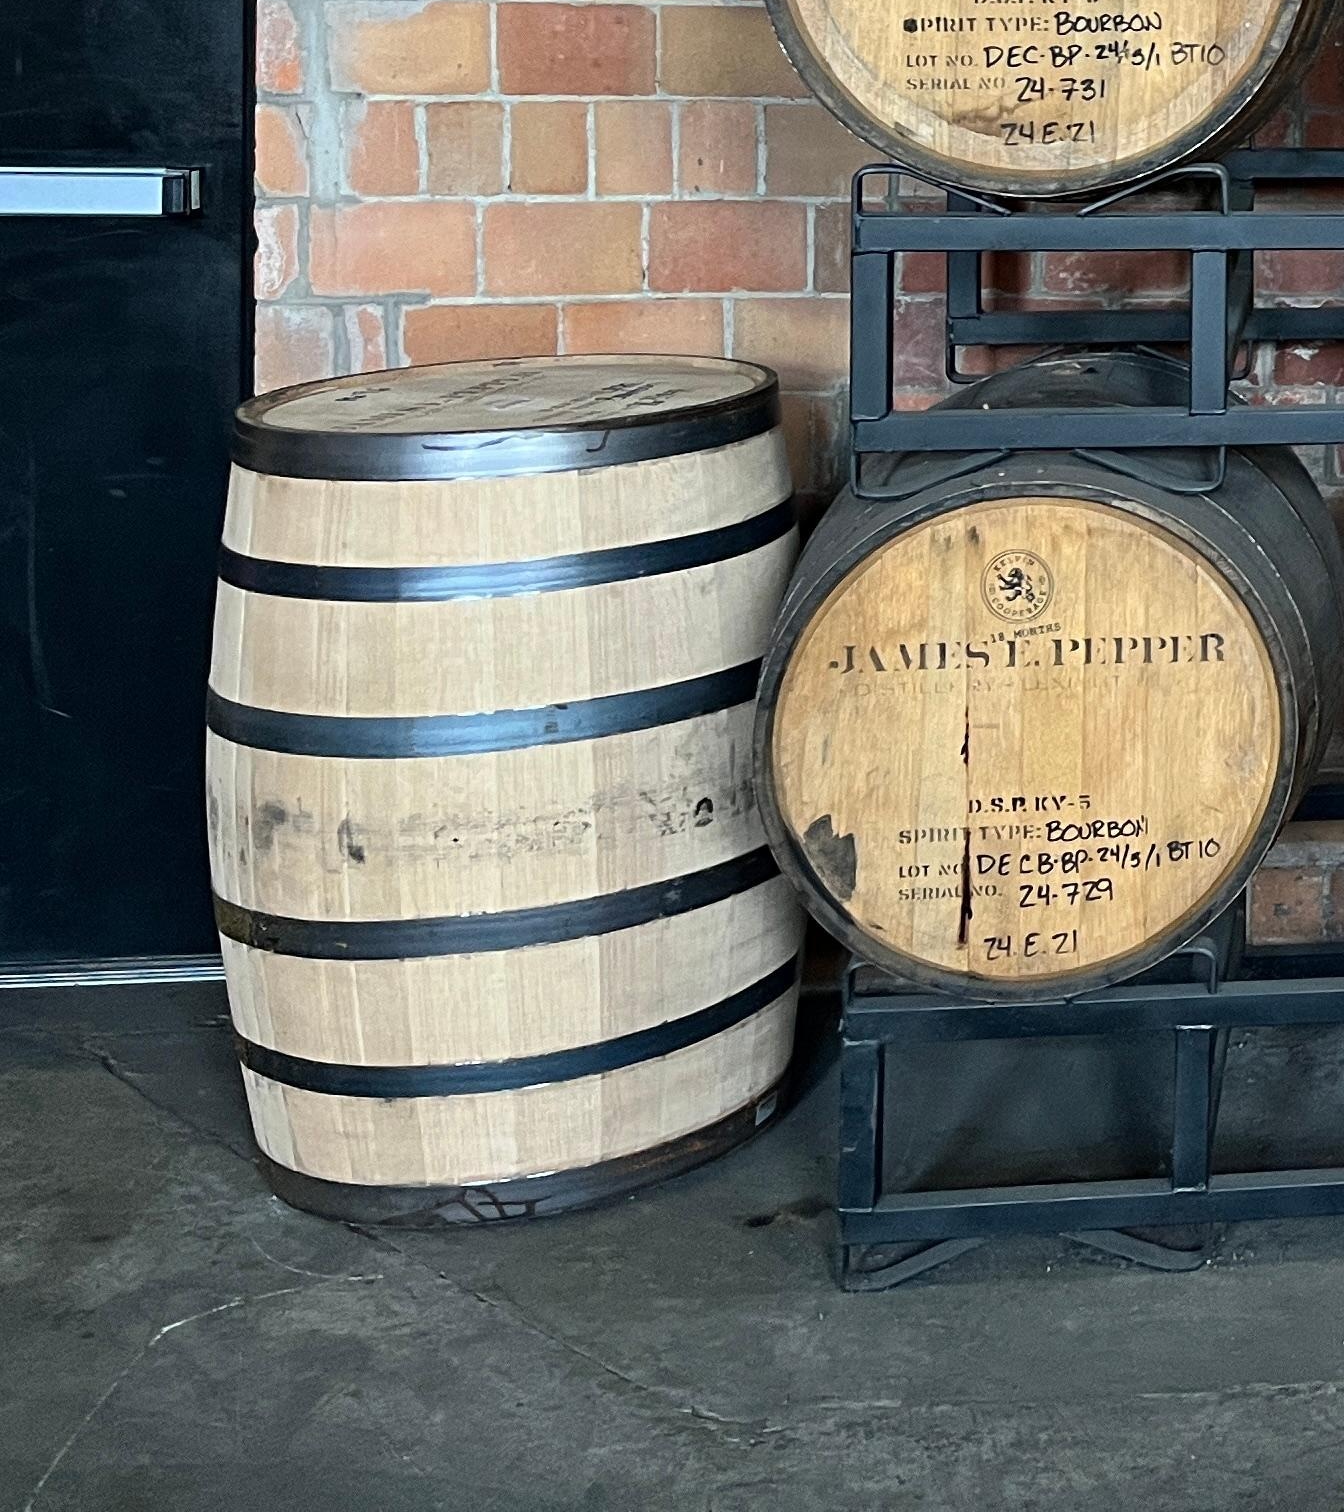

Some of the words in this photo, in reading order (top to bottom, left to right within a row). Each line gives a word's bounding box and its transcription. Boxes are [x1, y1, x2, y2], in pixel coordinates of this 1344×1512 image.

[985, 17, 1051, 32] TYPE:
[1053, 10, 1162, 36] BOURBON
[906, 54, 938, 68] LOT
[945, 54, 978, 68] NO.
[905, 77, 971, 90] SERIAL
[829, 640, 990, 675] JAMES
[1051, 632, 1226, 667] PEPPER
[898, 826, 971, 844] SPIRIT
[978, 824, 1042, 841] TYPE:
[1045, 815, 1149, 842] BOURBON
[898, 864, 931, 879] LOT
